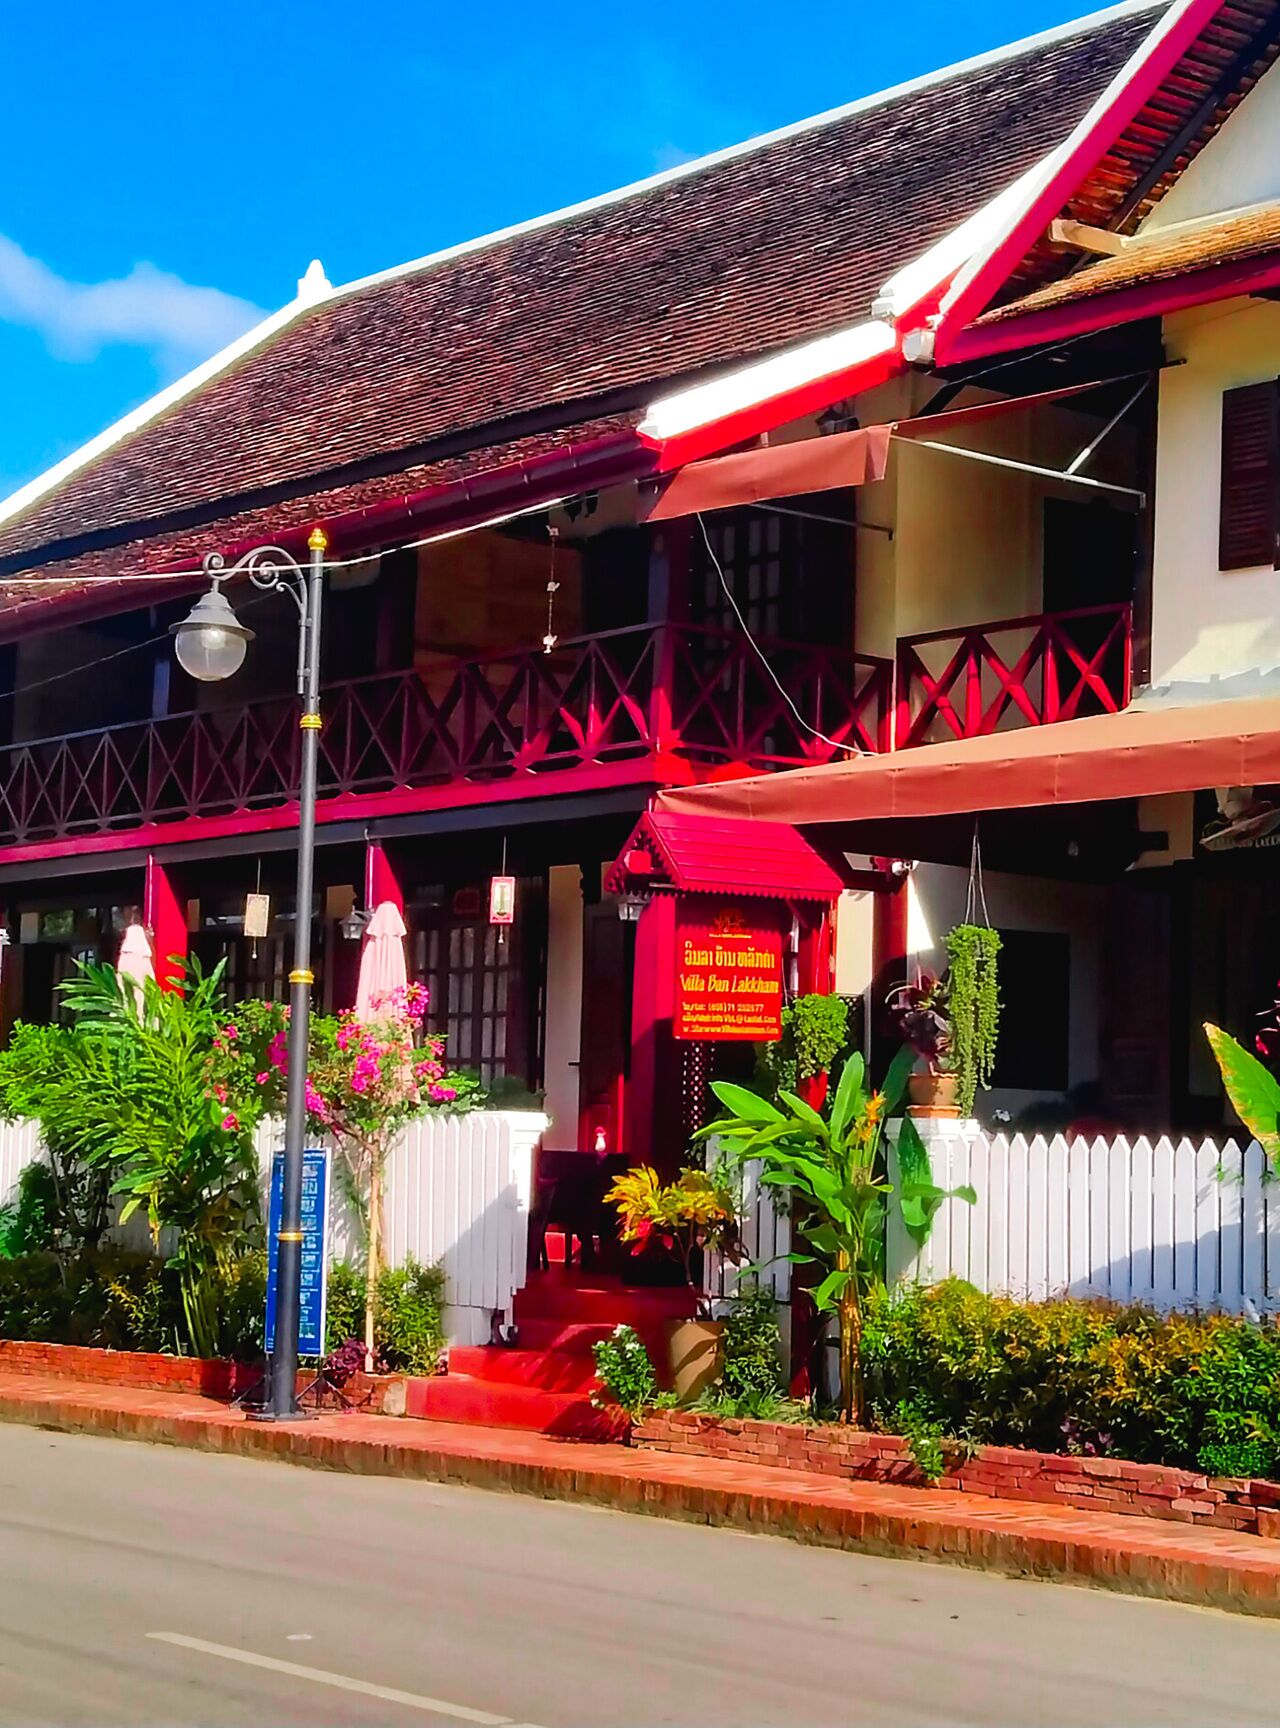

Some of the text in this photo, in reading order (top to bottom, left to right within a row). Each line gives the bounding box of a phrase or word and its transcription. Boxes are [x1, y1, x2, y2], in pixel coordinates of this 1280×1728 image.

[680, 973, 779, 994] Villa Ban Lakkham
